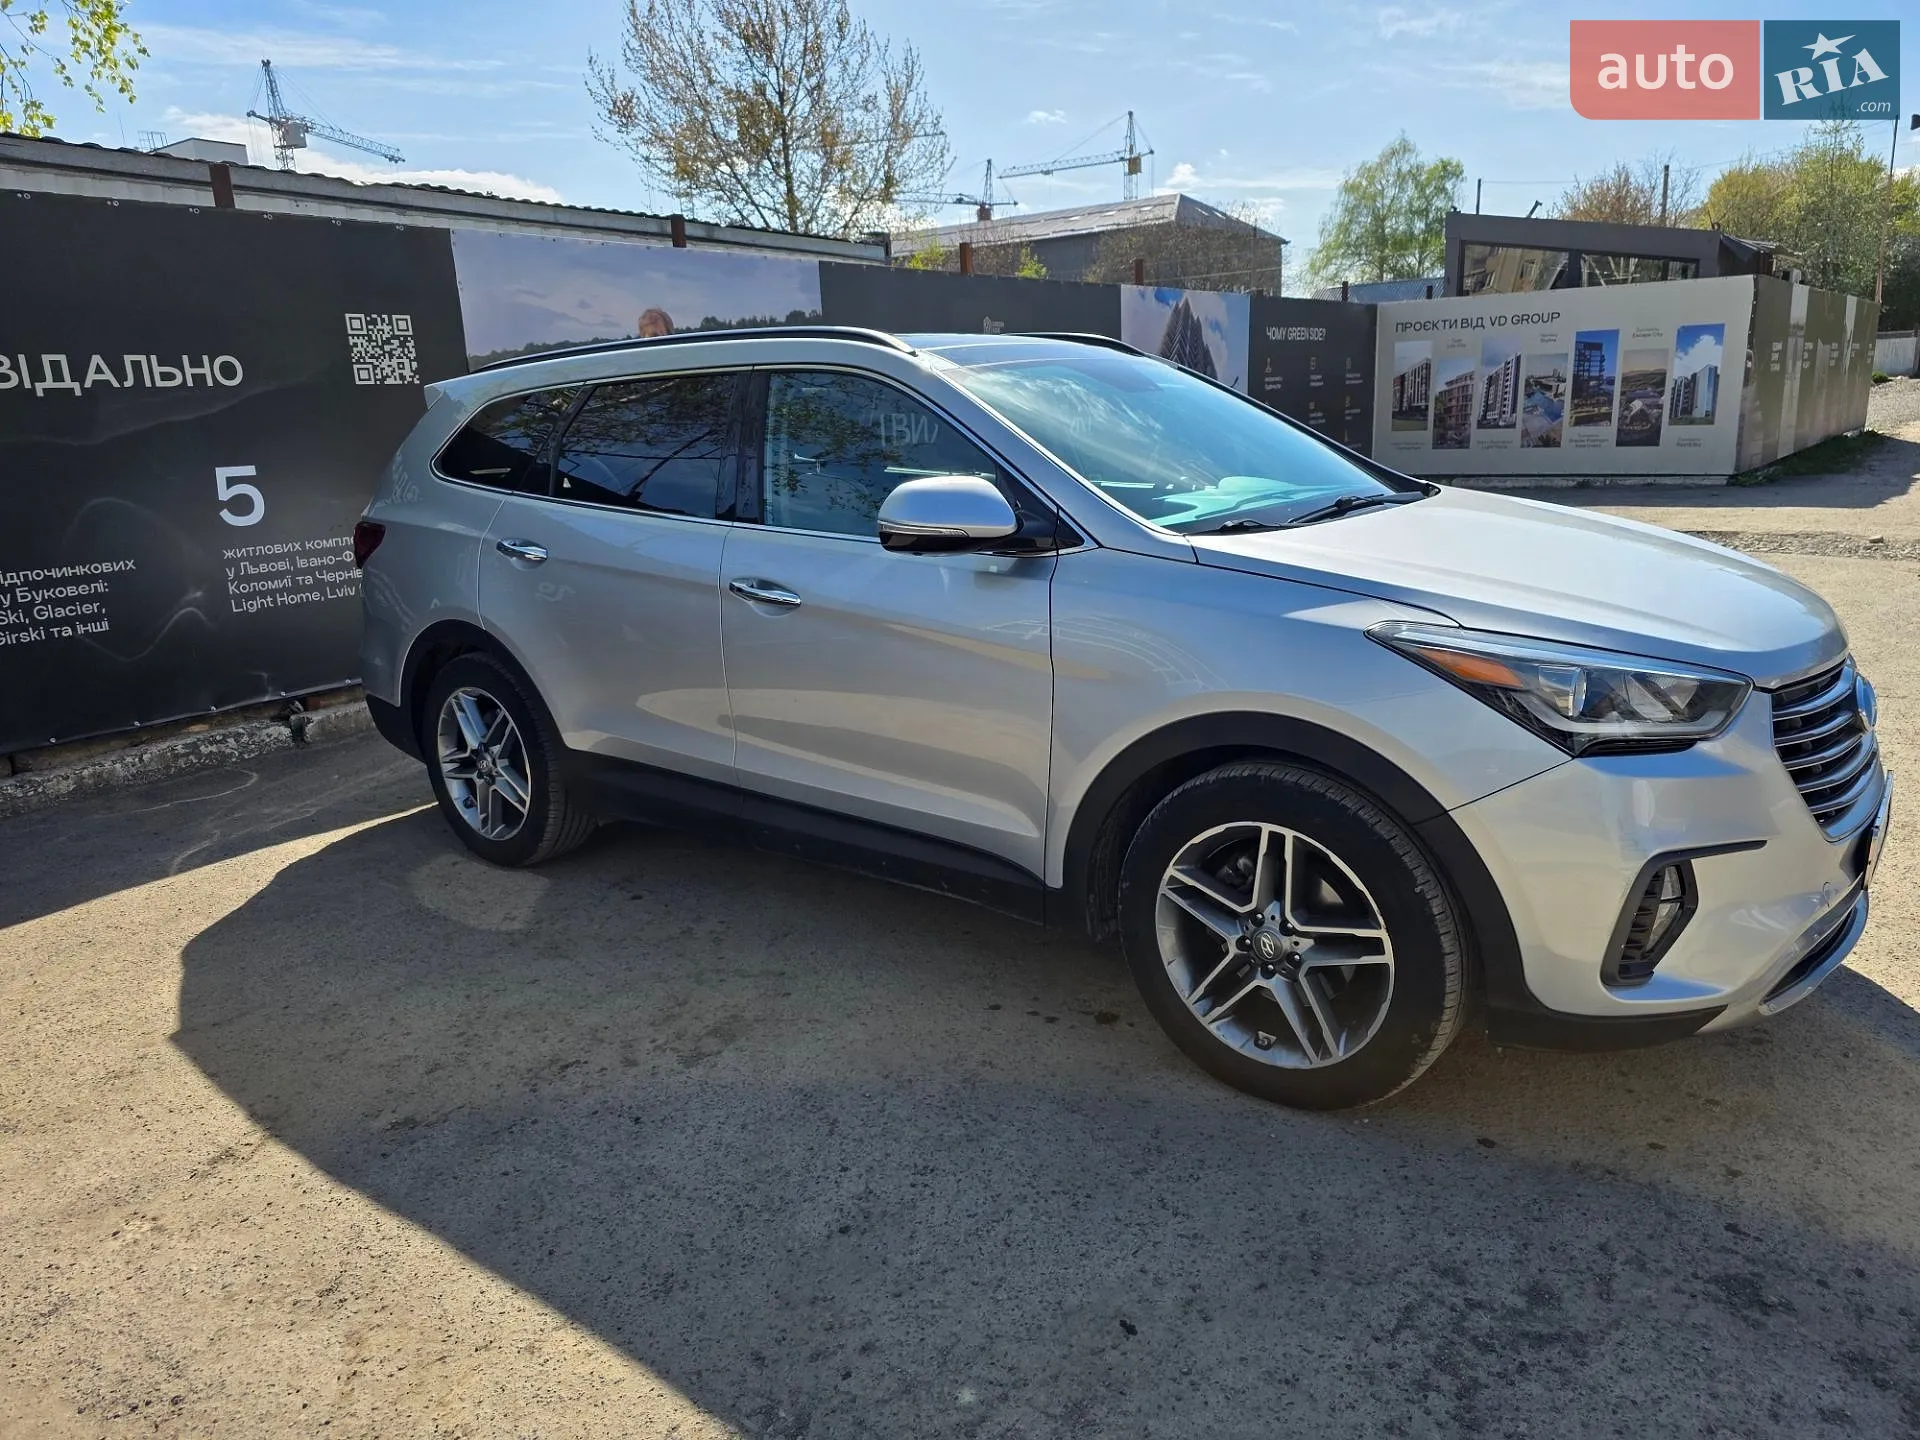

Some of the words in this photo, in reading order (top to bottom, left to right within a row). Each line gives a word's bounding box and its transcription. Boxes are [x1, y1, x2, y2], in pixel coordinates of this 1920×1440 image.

[1395, 320, 1458, 333] ПРОЄКТИ
[1460, 317, 1485, 331] ВІД
[1489, 315, 1507, 328] VD
[1511, 312, 1561, 326] GROUP
[1266, 326, 1287, 341] ЧОМУ
[215, 465, 265, 527] 5
[223, 542, 302, 559] житлових
[225, 567, 235, 580] у
[240, 558, 294, 575] Львові,
[16, 579, 109, 603] Буковелі:
[228, 575, 292, 595] Коломиї
[296, 575, 314, 585] та
[231, 596, 275, 613] Light
[276, 592, 325, 606] Home,
[326, 586, 356, 599] Lviv
[33, 601, 106, 620] Glacier,
[50, 626, 73, 638] та
[76, 618, 110, 635] інші
